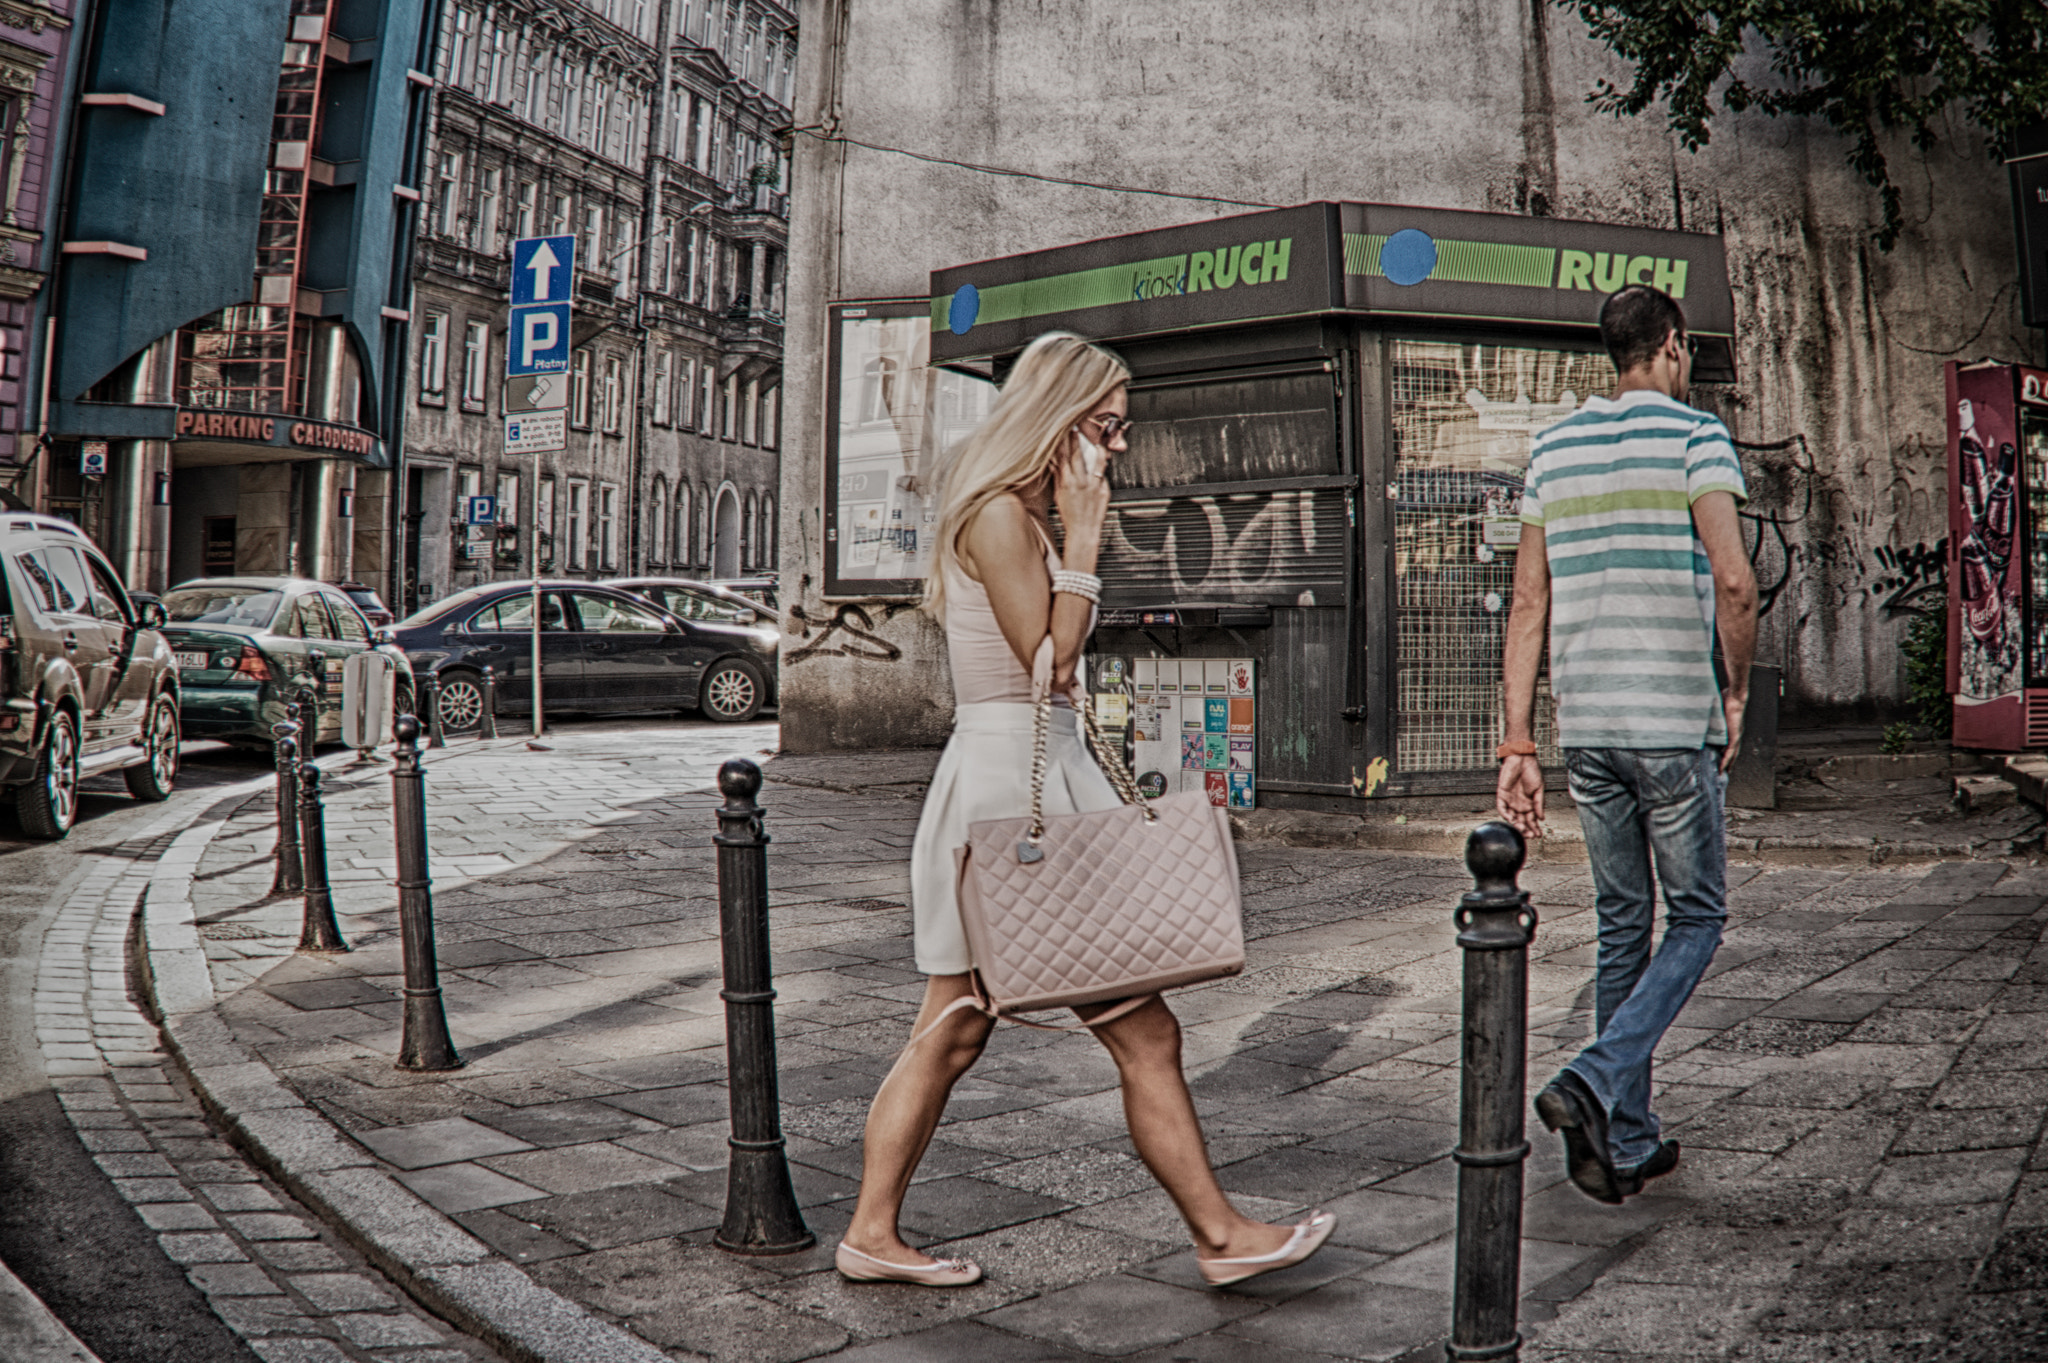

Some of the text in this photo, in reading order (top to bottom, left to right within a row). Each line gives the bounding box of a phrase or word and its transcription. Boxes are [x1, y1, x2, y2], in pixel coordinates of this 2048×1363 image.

[1133, 237, 1292, 302] kiosk RUCH
[1557, 249, 1688, 299] RUCH
[521, 311, 559, 367] P
[176, 411, 275, 441] PARKING
[474, 499, 490, 522] P
[1231, 723, 1253, 733] orange
[1231, 742, 1252, 750] PLAY
